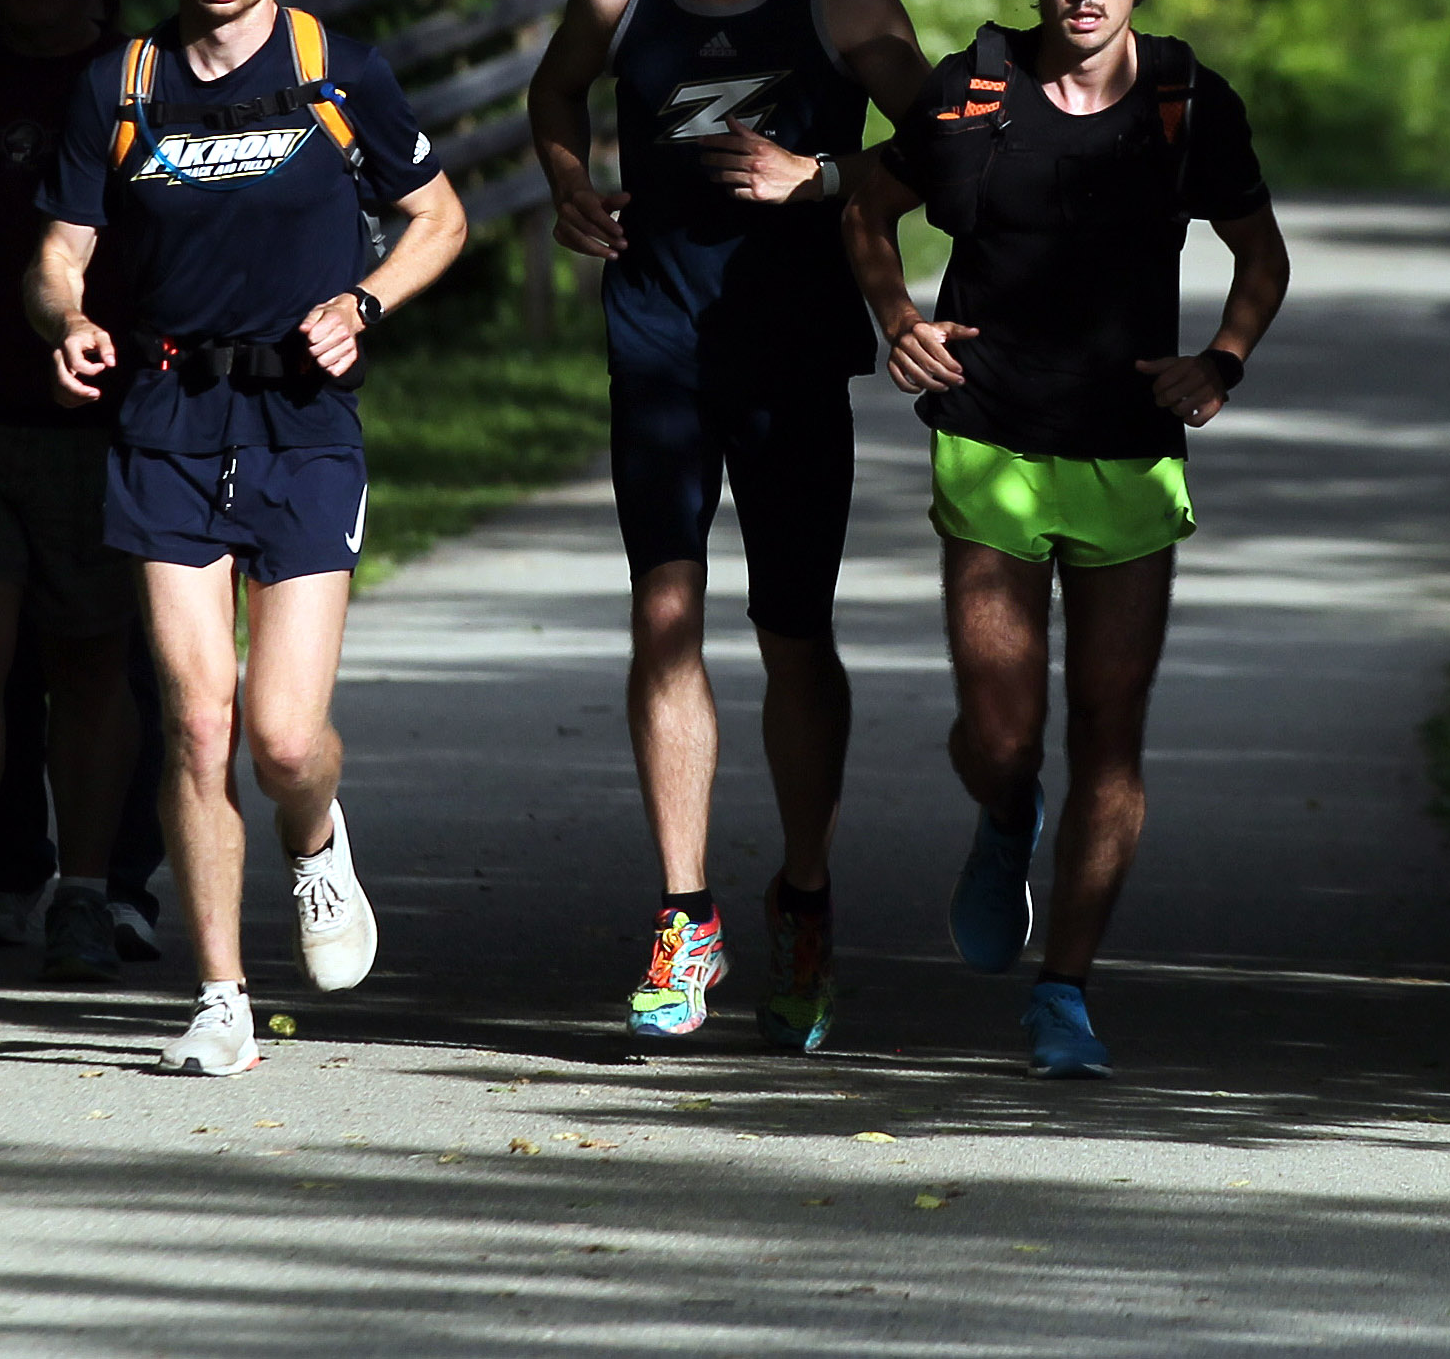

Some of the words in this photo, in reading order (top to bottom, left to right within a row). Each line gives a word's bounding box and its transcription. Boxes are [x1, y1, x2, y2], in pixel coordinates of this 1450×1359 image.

[699, 48, 738, 57] adidas
[662, 72, 785, 142] Z
[140, 133, 296, 175] AKRON
